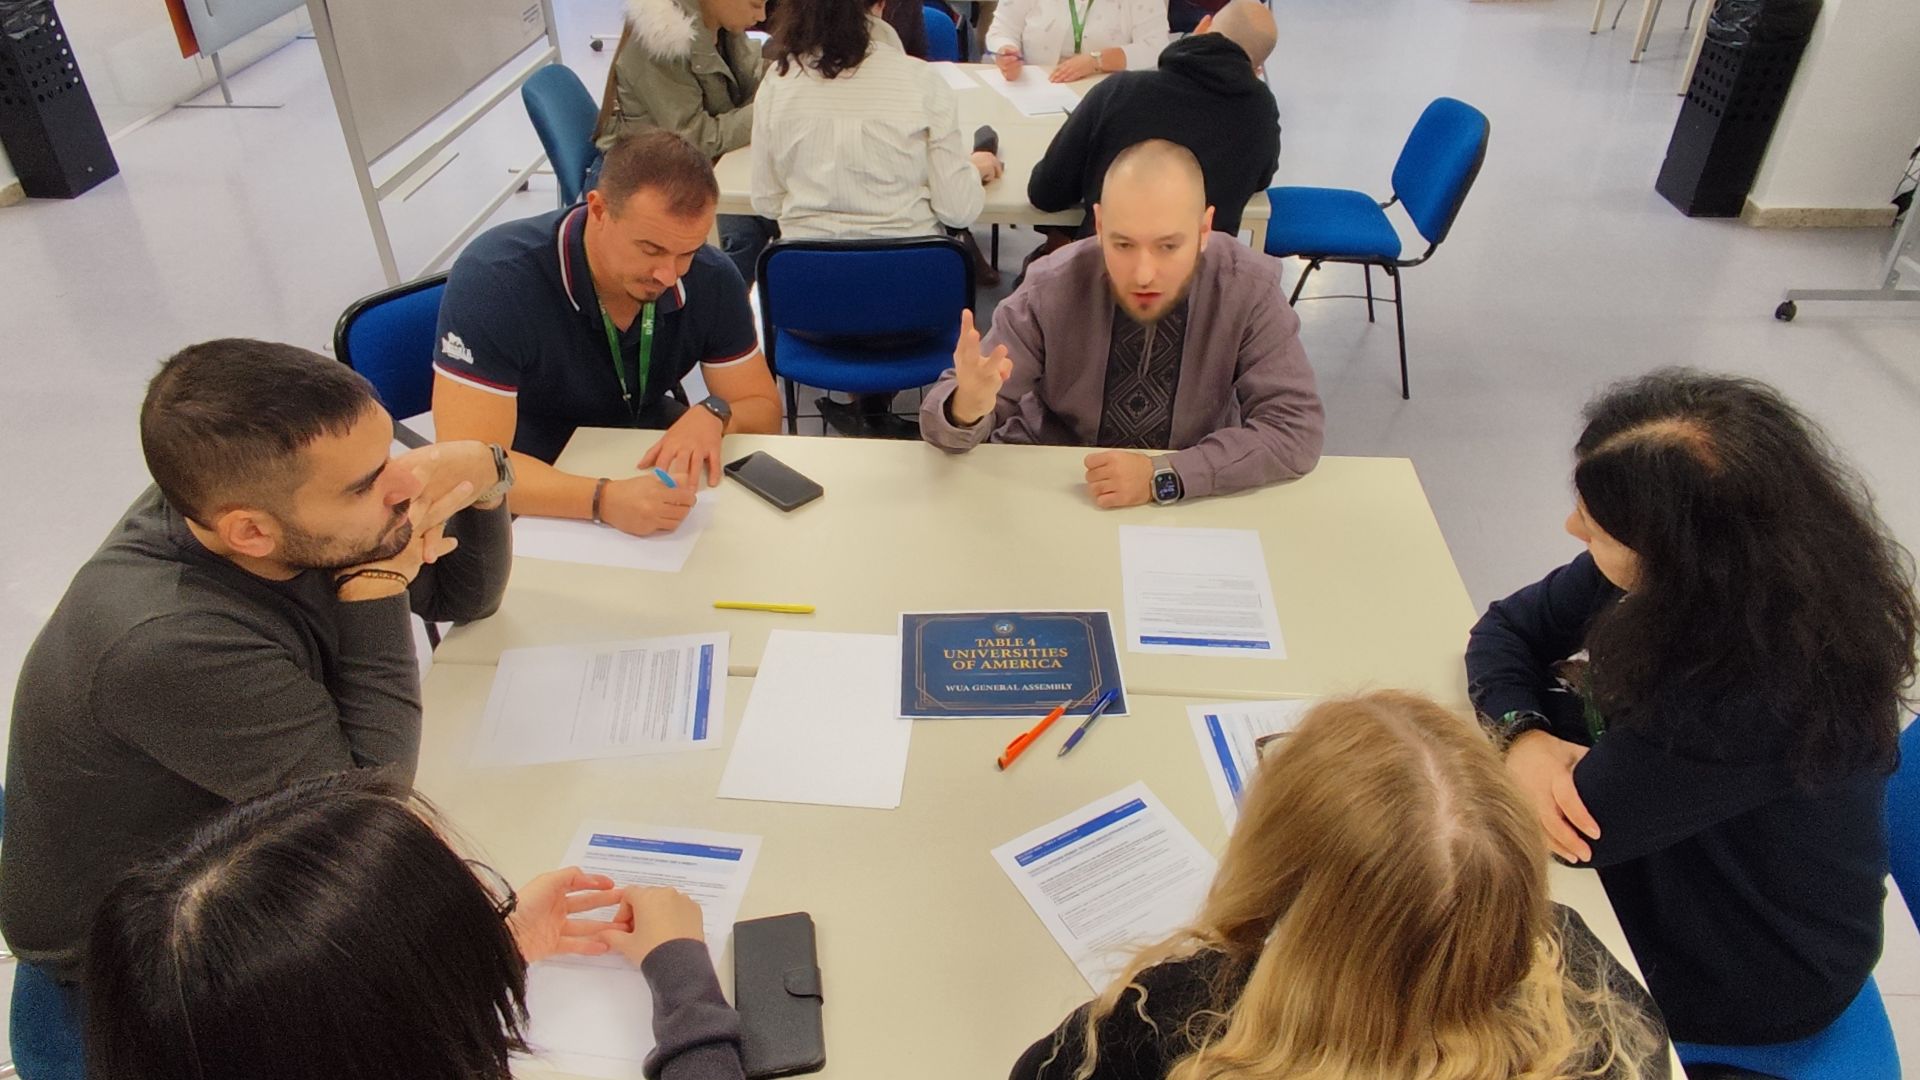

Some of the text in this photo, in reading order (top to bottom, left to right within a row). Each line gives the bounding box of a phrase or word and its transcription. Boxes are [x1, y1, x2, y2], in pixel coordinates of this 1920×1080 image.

[975, 638, 1036, 647] TABLE 4
[943, 648, 1068, 658] UNIVERSITIES
[952, 659, 1063, 670] OF AMERICA
[945, 683, 1072, 692] WUA GENERAL ASSEMBLY
